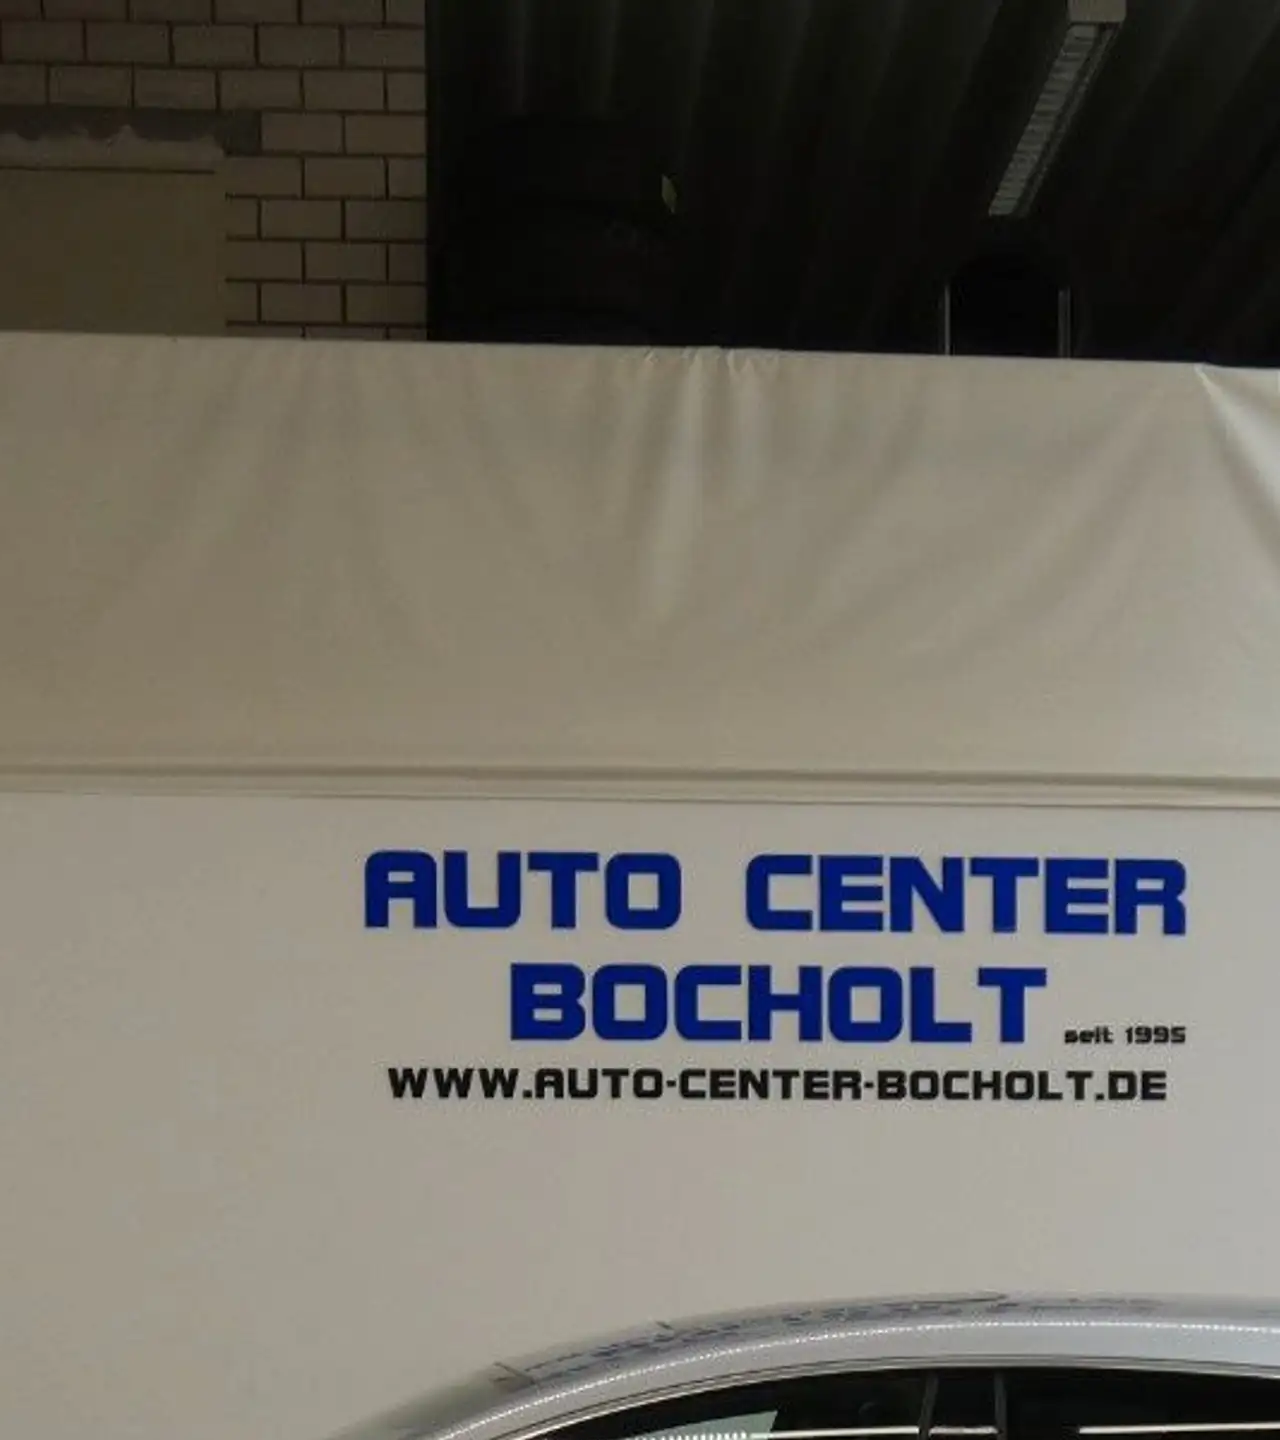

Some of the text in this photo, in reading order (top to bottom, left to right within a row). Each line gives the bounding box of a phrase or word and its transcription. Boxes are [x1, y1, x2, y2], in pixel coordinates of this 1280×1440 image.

[364, 850, 1186, 935] AUTO CENTER
[510, 963, 1186, 1045] BOCHOLT seit 1995
[388, 1067, 1167, 1101] WWW.AUTO-CENTER-BOCHOLT.DE
